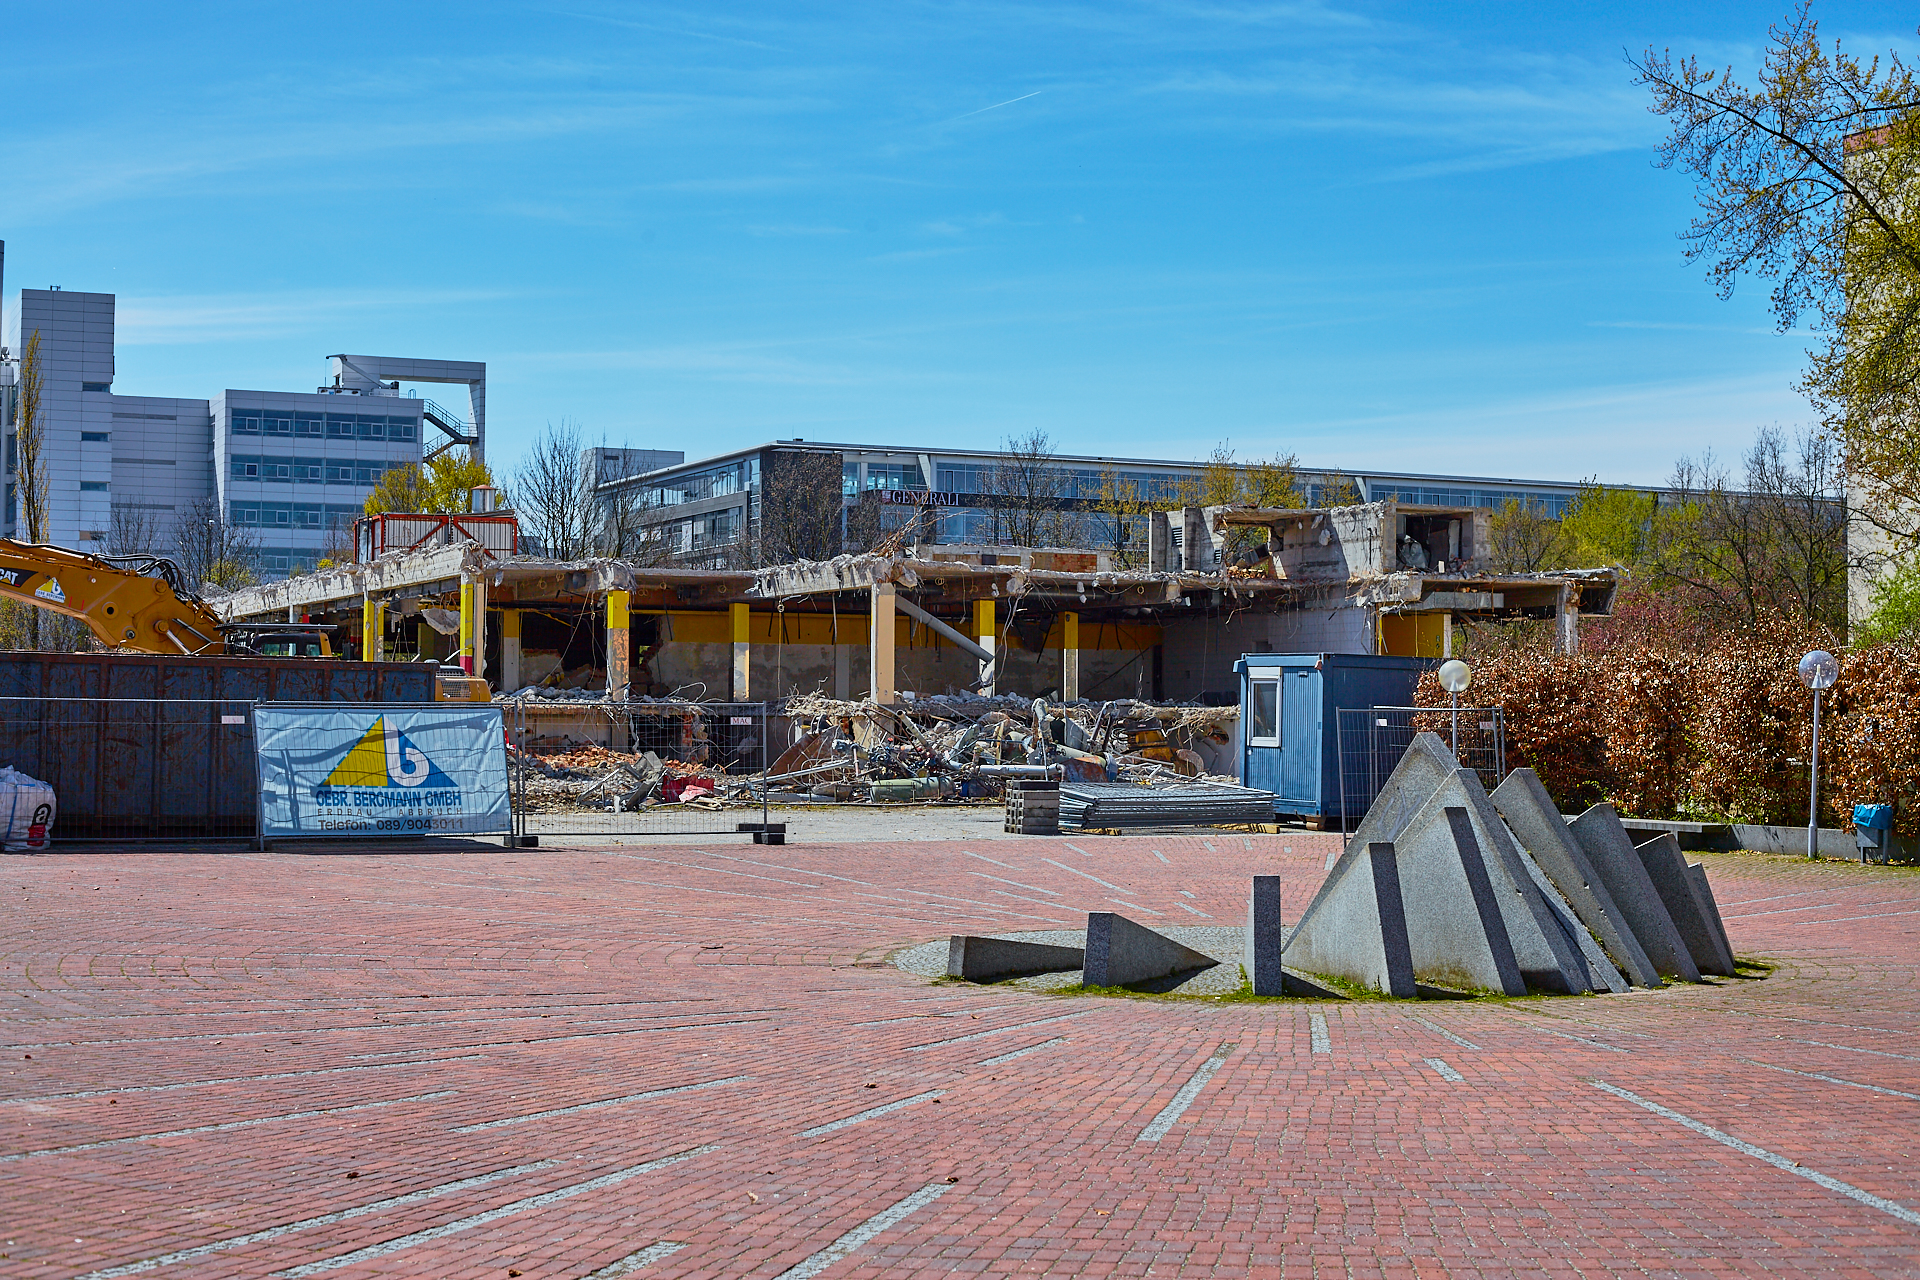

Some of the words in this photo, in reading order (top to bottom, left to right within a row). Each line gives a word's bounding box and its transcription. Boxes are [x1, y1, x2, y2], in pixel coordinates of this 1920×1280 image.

[892, 490, 960, 506] GENERALI
[0, 568, 19, 585] CAT
[316, 790, 351, 807] GEBR.
[353, 790, 421, 807] BERGMANN
[425, 790, 462, 807] GMBH
[317, 808, 372, 816] ERDBAU
[399, 807, 462, 816] ABBRUCH
[318, 819, 371, 831] Telefon:
[377, 818, 463, 831] 089/9043011
